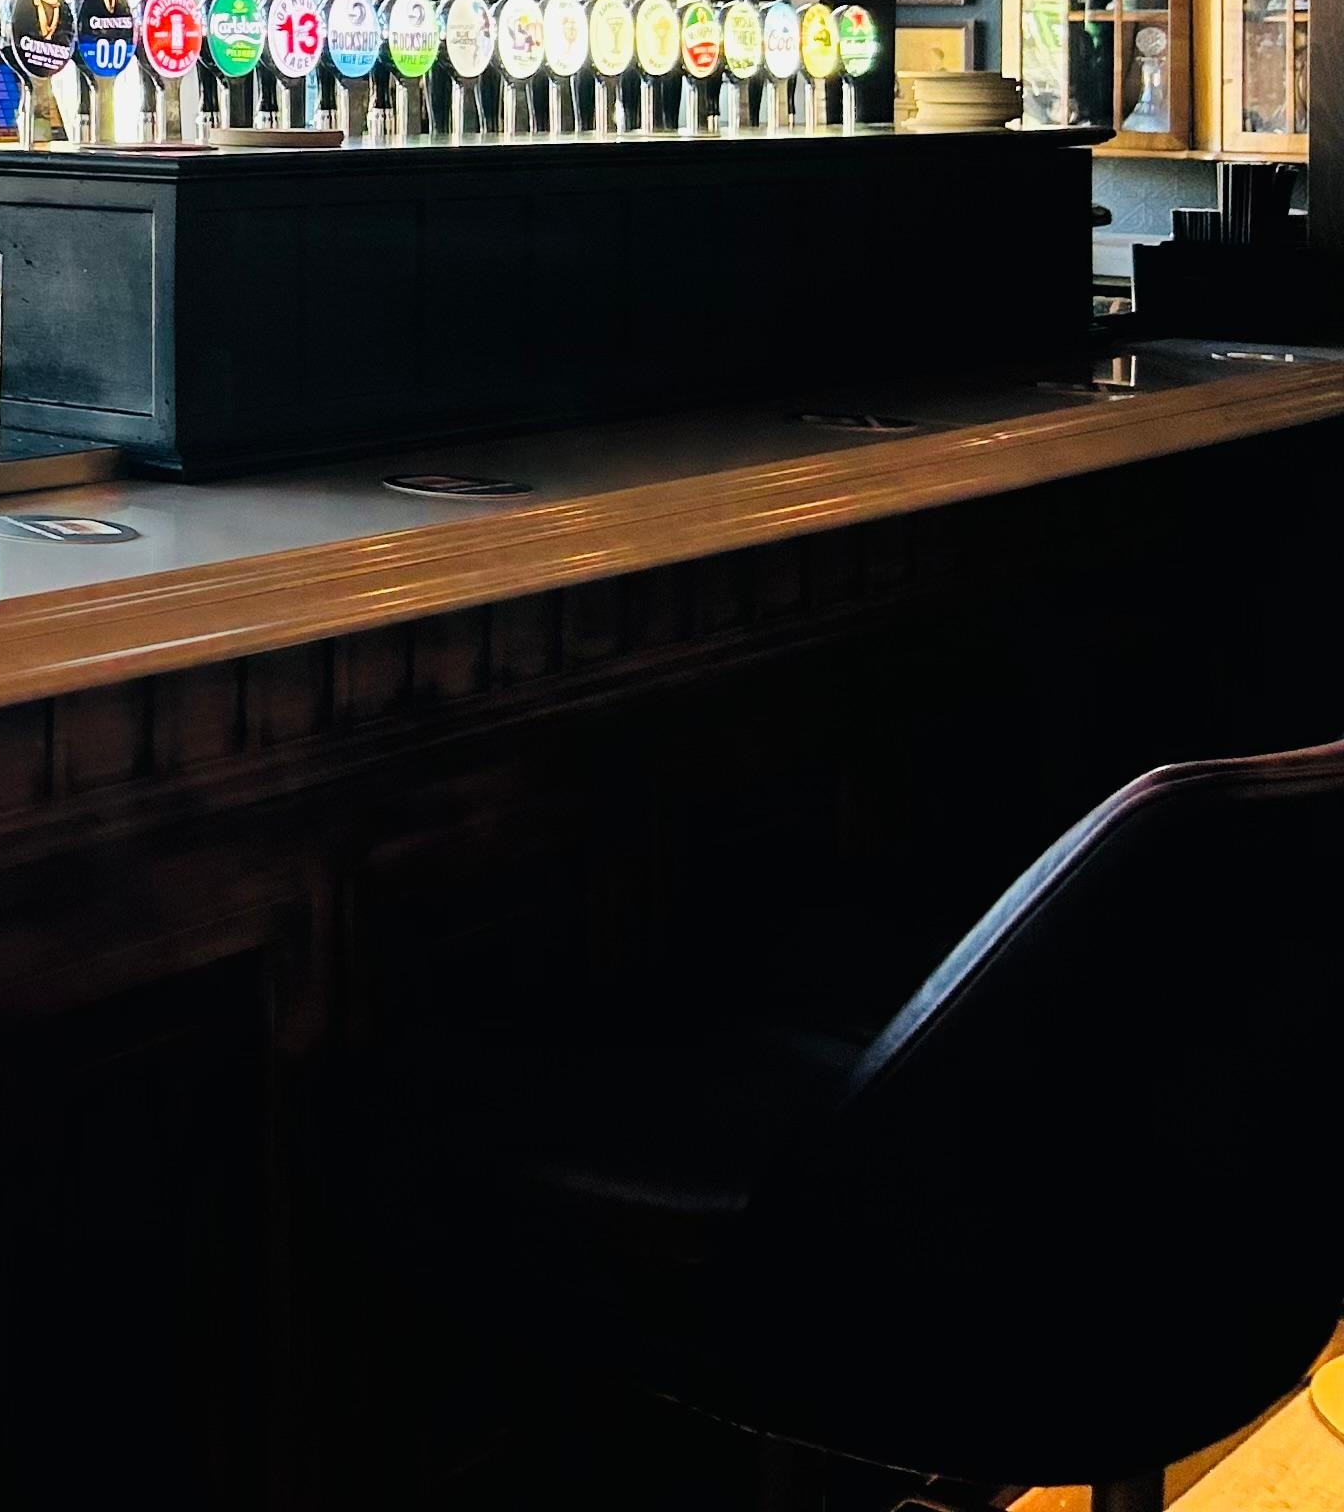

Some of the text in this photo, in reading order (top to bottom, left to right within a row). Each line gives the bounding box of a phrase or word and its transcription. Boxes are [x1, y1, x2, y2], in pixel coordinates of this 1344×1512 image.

[89, 16, 133, 30] GUINNESS
[276, 13, 320, 55] 13
[20, 35, 71, 60] GUINNESS
[96, 38, 128, 69] 0.0
